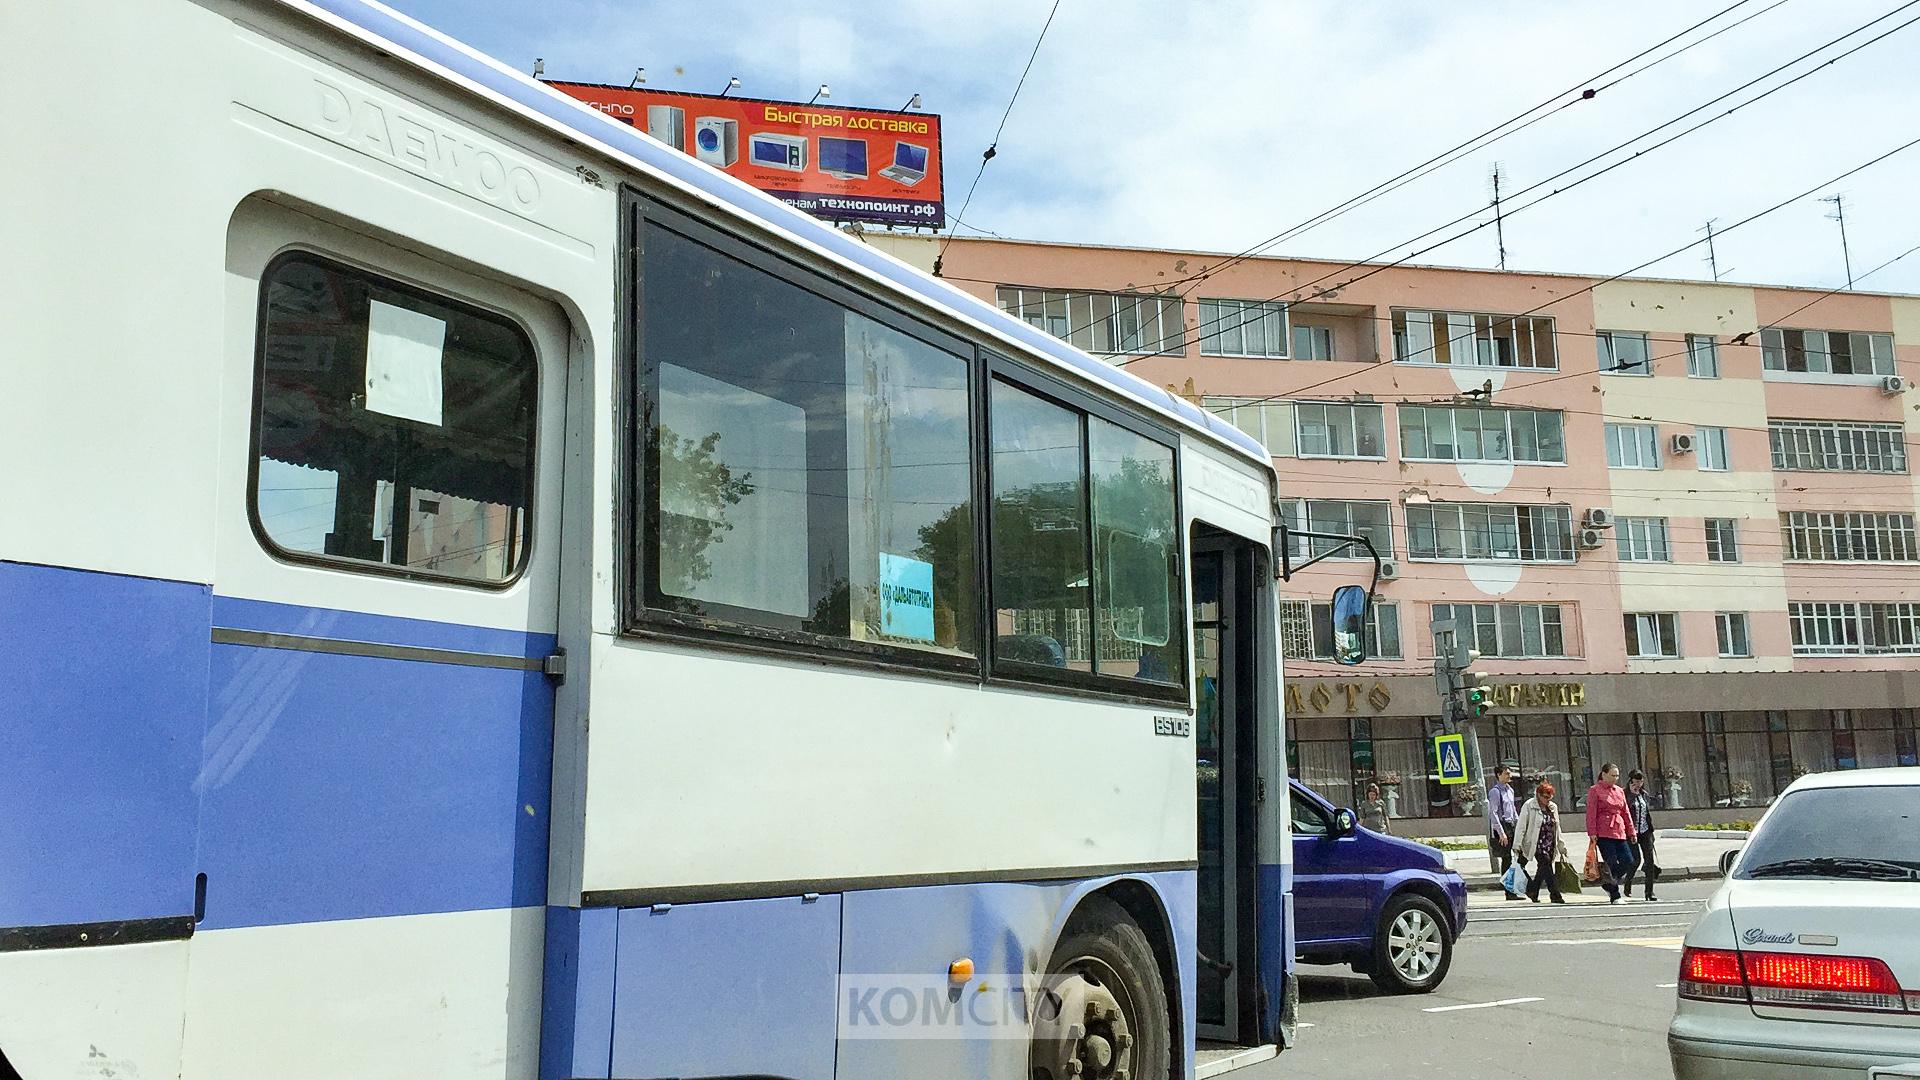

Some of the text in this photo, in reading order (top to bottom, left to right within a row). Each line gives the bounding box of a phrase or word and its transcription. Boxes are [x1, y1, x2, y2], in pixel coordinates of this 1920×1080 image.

[764, 106, 929, 134] Быстрая доставка
[782, 198, 937, 217] енам технопоинт.рф
[1485, 683, 1585, 707] АГАЗИН
